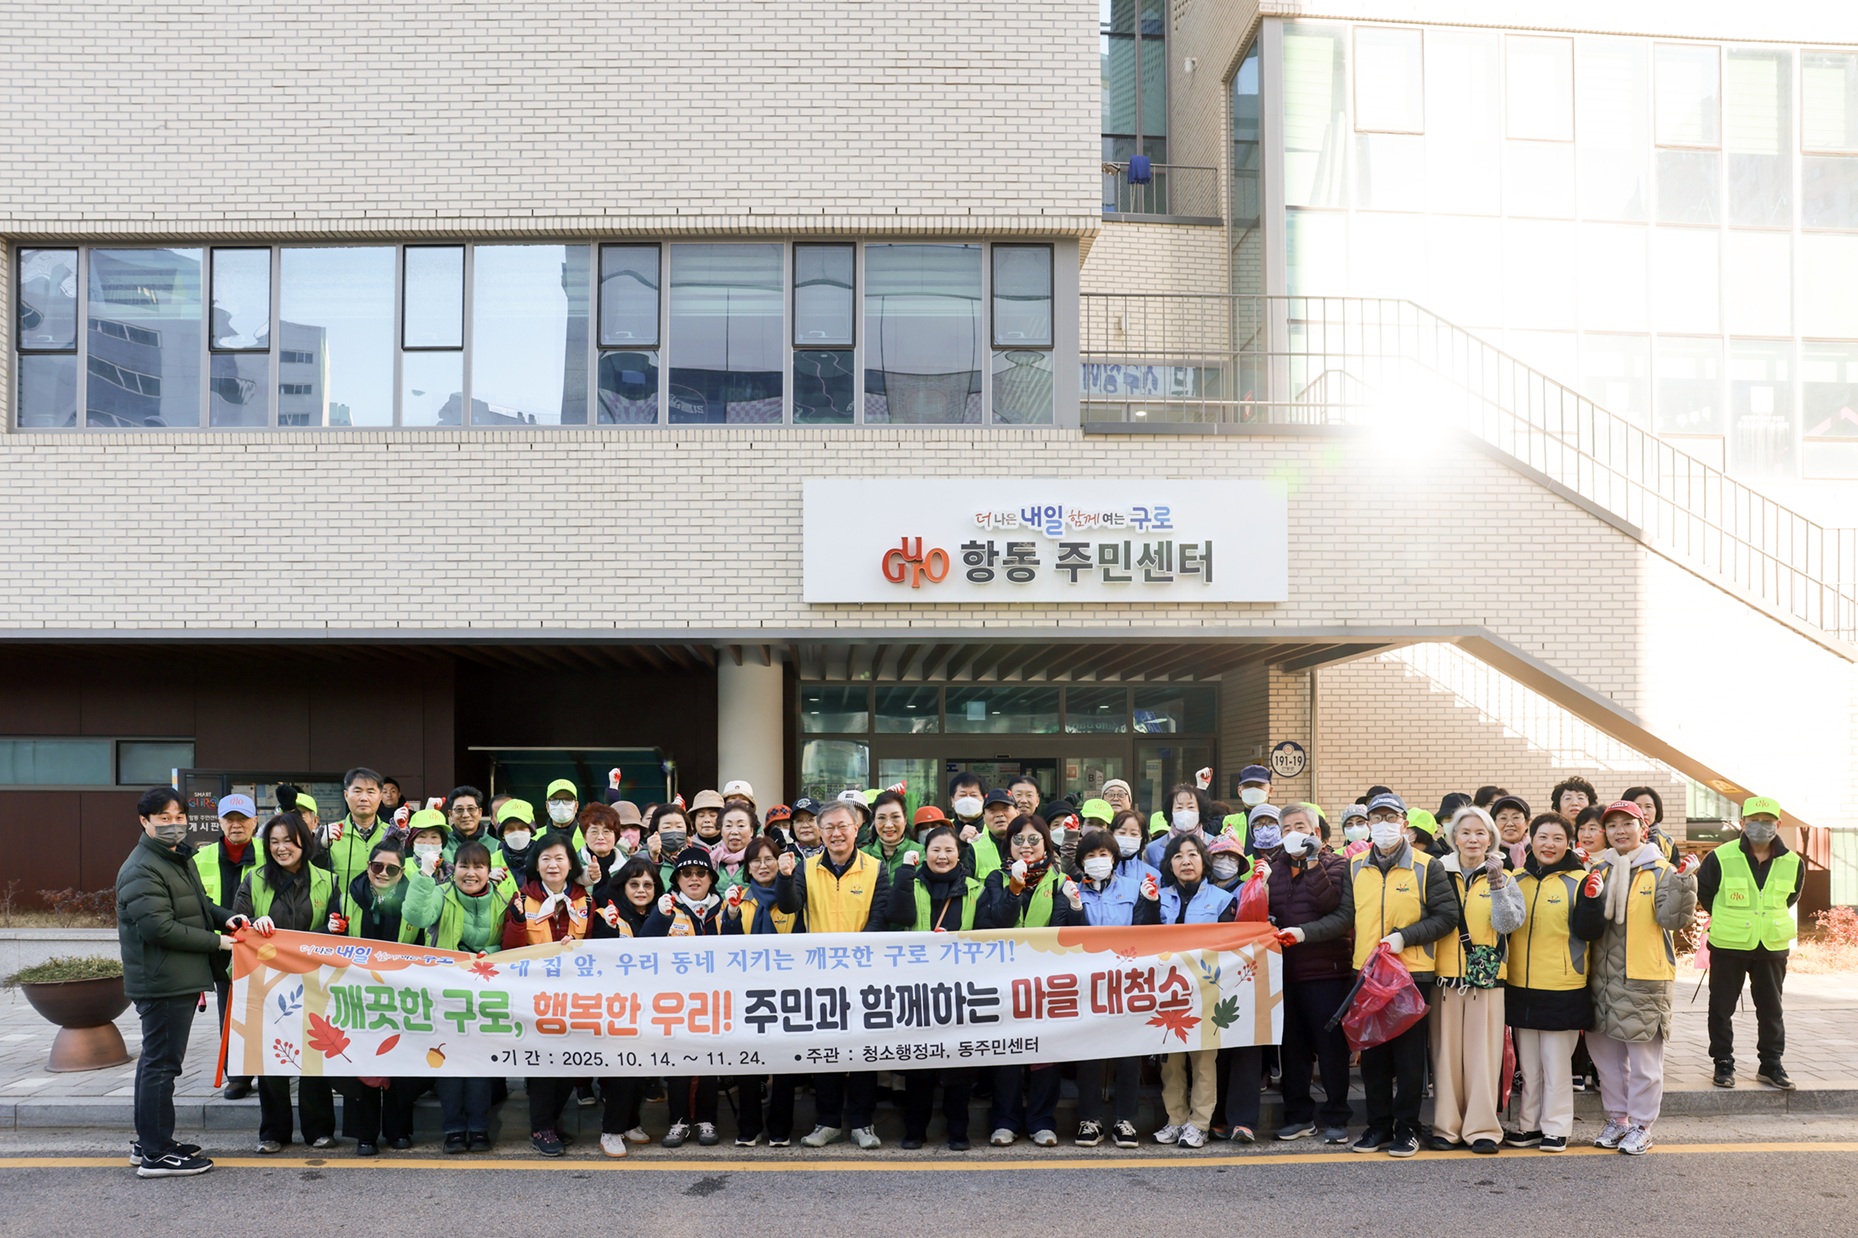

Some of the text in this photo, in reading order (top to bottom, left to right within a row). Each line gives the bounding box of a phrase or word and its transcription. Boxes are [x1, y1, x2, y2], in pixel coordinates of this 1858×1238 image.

[975, 505, 1174, 535] 더 나은 내일 함께 여는 구로
[960, 539, 1214, 584] 항동 주민센터
[1275, 755, 1303, 767] 191-19
[188, 822, 220, 832] 게시판
[336, 945, 372, 964] 내일
[542, 959, 562, 977] 집
[574, 954, 603, 977] 앞,
[616, 953, 659, 976] 우리
[671, 951, 715, 974] 동네
[726, 949, 794, 974] 지키는
[805, 945, 874, 970] 깨끗한
[884, 943, 930, 968] 구로
[940, 939, 1016, 965] 가꾸기!
[329, 965, 1194, 1039] 깨끗한 구로, 행복한 우리! 주민과 함께하는 마을 대청소
[562, 1051, 610, 1068] 2025.
[617, 1051, 643, 1067] 10.
[650, 1051, 675, 1067] 14.
[707, 1050, 731, 1066] 11.
[739, 1050, 766, 1066] 24.
[806, 1047, 840, 1065] 주관
[862, 1042, 951, 1065] 청소행정과,
[957, 1036, 1040, 1057] 동주민센터
